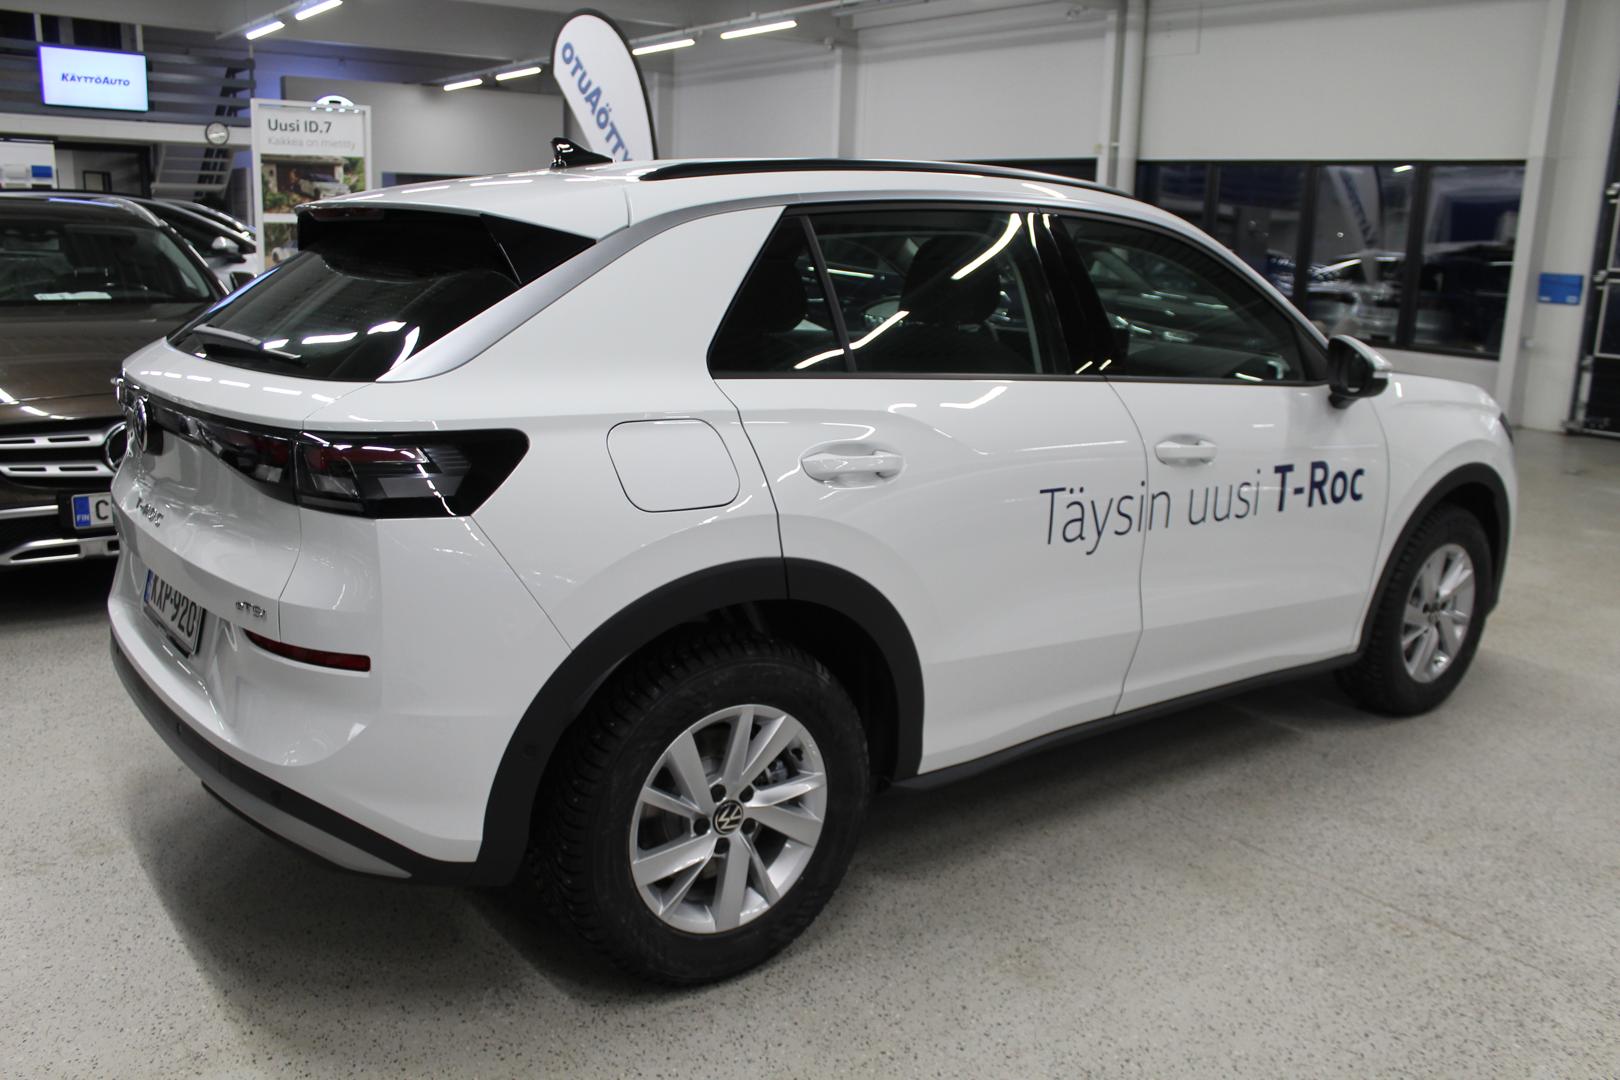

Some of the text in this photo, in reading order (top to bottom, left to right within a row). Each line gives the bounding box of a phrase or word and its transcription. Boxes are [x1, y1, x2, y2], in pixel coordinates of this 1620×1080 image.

[267, 118, 332, 134] Uusi ID.7
[1039, 460, 1365, 555] Täysin uusi T-Roc
[151, 574, 198, 638] KXP-920
